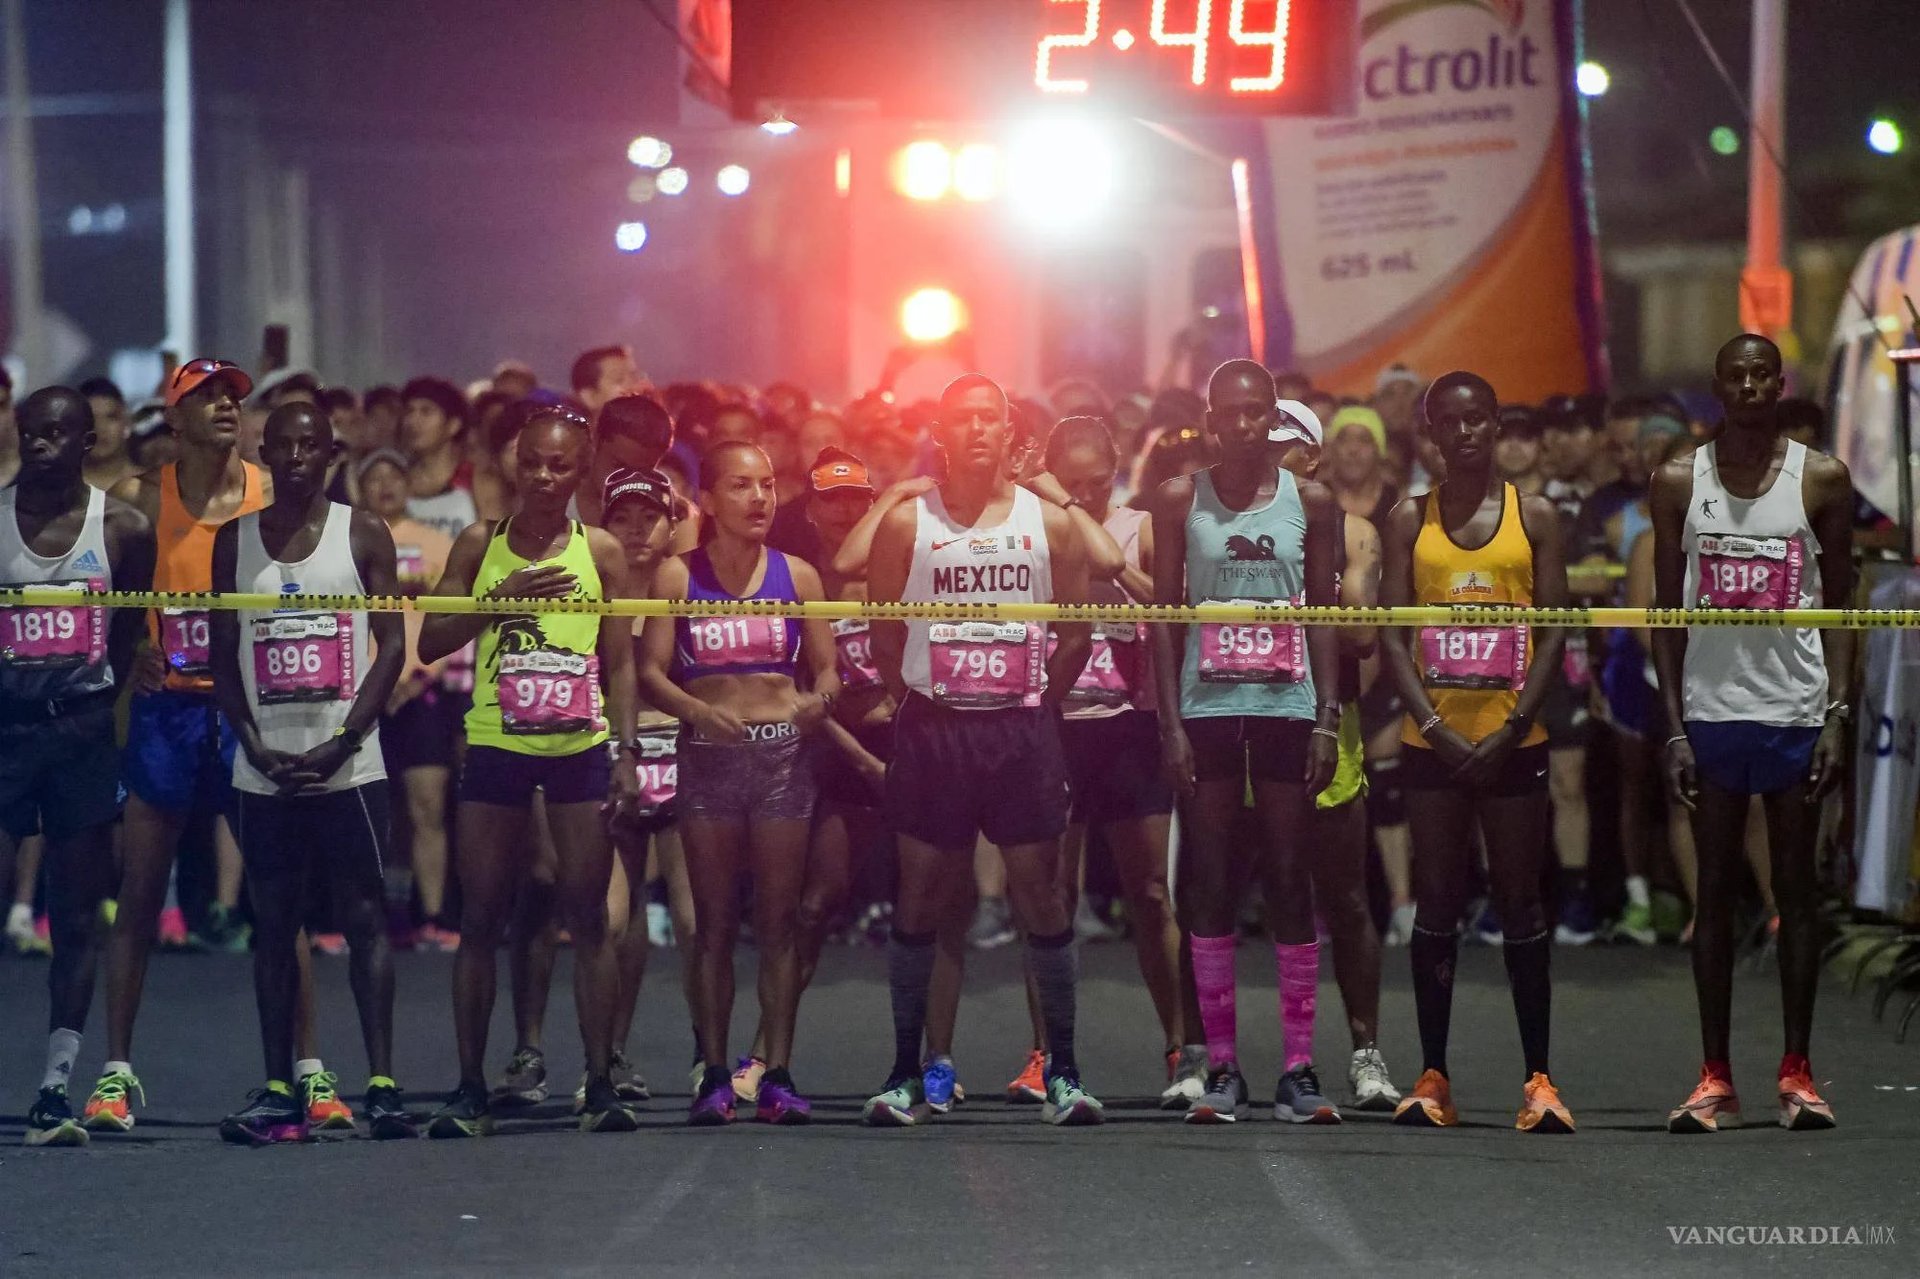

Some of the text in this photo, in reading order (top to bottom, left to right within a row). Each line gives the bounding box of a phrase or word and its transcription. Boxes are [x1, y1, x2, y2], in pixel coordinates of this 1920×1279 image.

[933, 564, 1030, 594] MEXICO
[1710, 563, 1770, 593] 1818
[10, 610, 75, 642] 1819
[690, 619, 750, 651] 1811
[1218, 625, 1274, 656] 959
[267, 644, 322, 676] 896
[1435, 631, 1499, 660] 1817
[950, 649, 1007, 678] 796
[516, 678, 573, 708] 979
